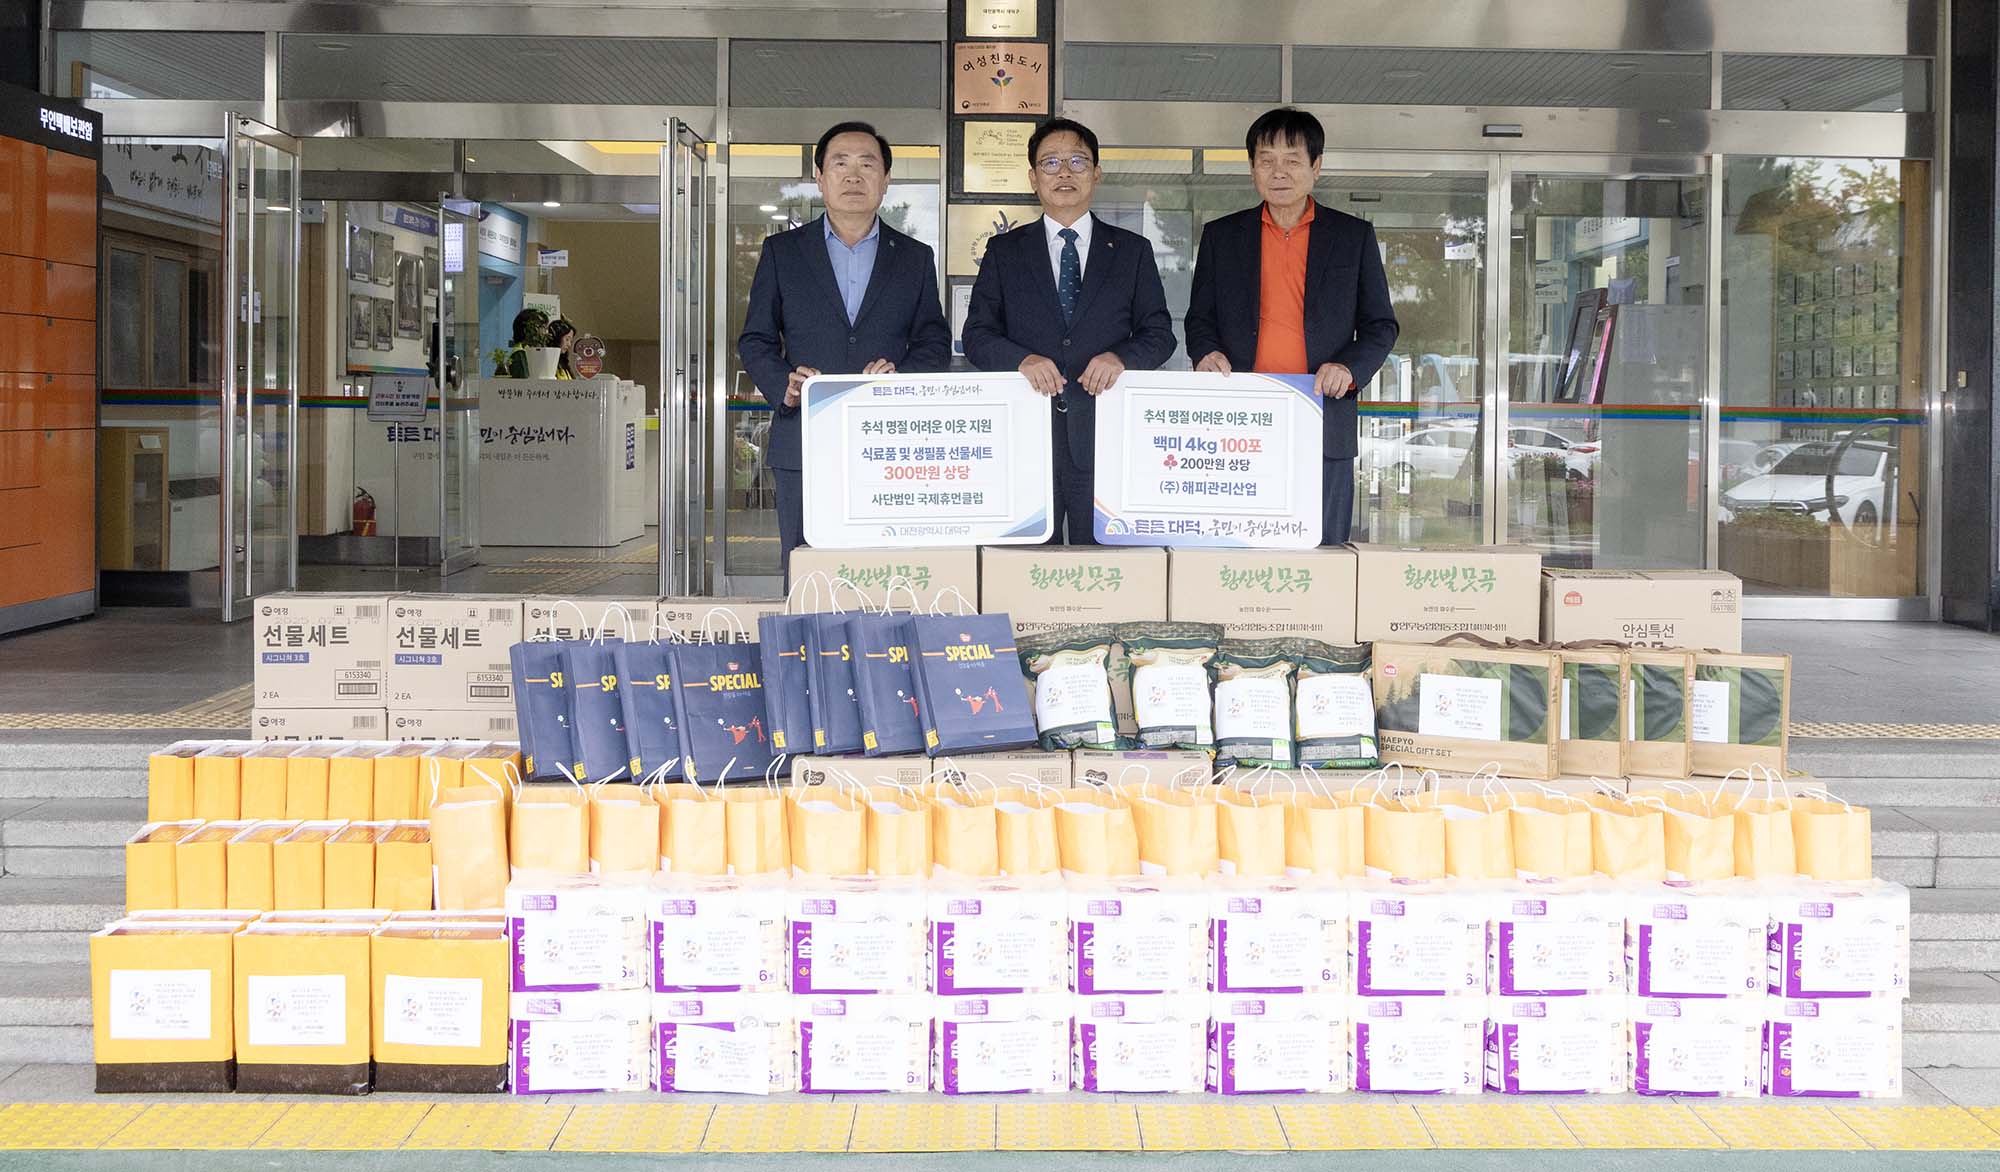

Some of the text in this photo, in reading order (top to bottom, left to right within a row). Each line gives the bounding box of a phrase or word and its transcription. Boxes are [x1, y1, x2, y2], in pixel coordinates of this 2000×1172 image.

[963, 52, 1042, 73] 여성친화도시
[40, 107, 94, 142] 무인택배보관함
[1144, 409, 1273, 426] 추석 명절 어려운 이웃 지원
[861, 419, 992, 435] 추석 명절 어려운 이웃 지원
[1153, 435, 1263, 454] 백미 4kg 100포
[861, 446, 993, 462] 식료품 및 생필품 선물세트
[1180, 457, 1250, 471] 200만원 상당
[884, 465, 971, 481] 300만원 상당
[1159, 480, 1257, 496] (주) 해피관리산업
[871, 492, 984, 506] 사단법인 국제휴먼클럽
[900, 525, 971, 537] 대전광역시 대덕구
[1168, 519, 1205, 536] 대덕,
[1029, 563, 1086, 592] 황산벌
[1220, 564, 1275, 593] 황산벌
[1404, 564, 1459, 593] 황산벌
[273, 607, 289, 615] 애경
[406, 608, 422, 617] 애경
[677, 612, 693, 620] 애경
[263, 625, 350, 648] 선물세트
[396, 626, 483, 649] 선물세트
[1622, 623, 1675, 638] 안심특선
[945, 644, 995, 663] SPECIAL
[344, 671, 372, 679] 6153340
[476, 674, 504, 682] 6153340
[709, 673, 762, 692] SPECIAL
[262, 691, 268, 699] 2
[394, 692, 400, 700] 2
[270, 718, 286, 726] 애경
[406, 718, 422, 727] 애경
[1380, 736, 1414, 746] HAEPYO
[1380, 744, 1452, 757] SPECIAL GIFT SET
